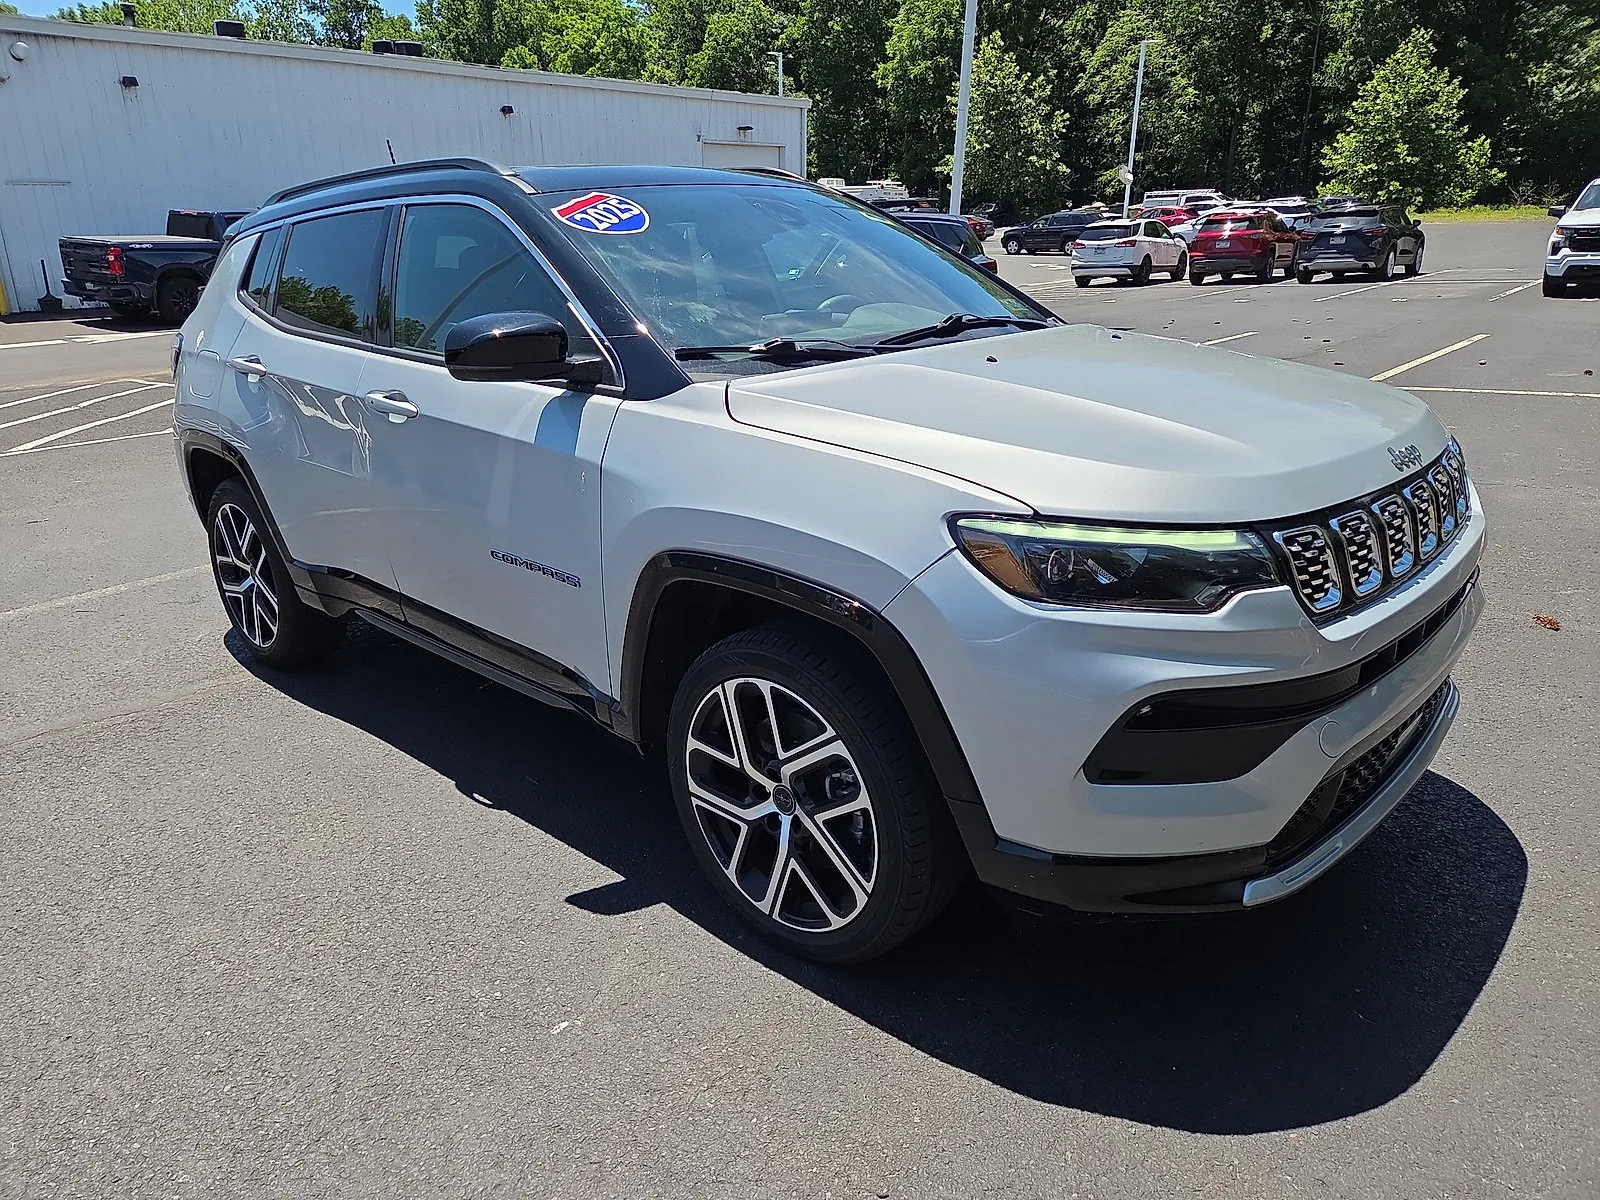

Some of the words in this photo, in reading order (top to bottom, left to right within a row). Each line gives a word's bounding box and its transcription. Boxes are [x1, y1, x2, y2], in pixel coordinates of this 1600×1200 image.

[573, 198, 641, 230] 2025
[1386, 444, 1423, 473] Jeep
[489, 548, 581, 588] COMPASS
